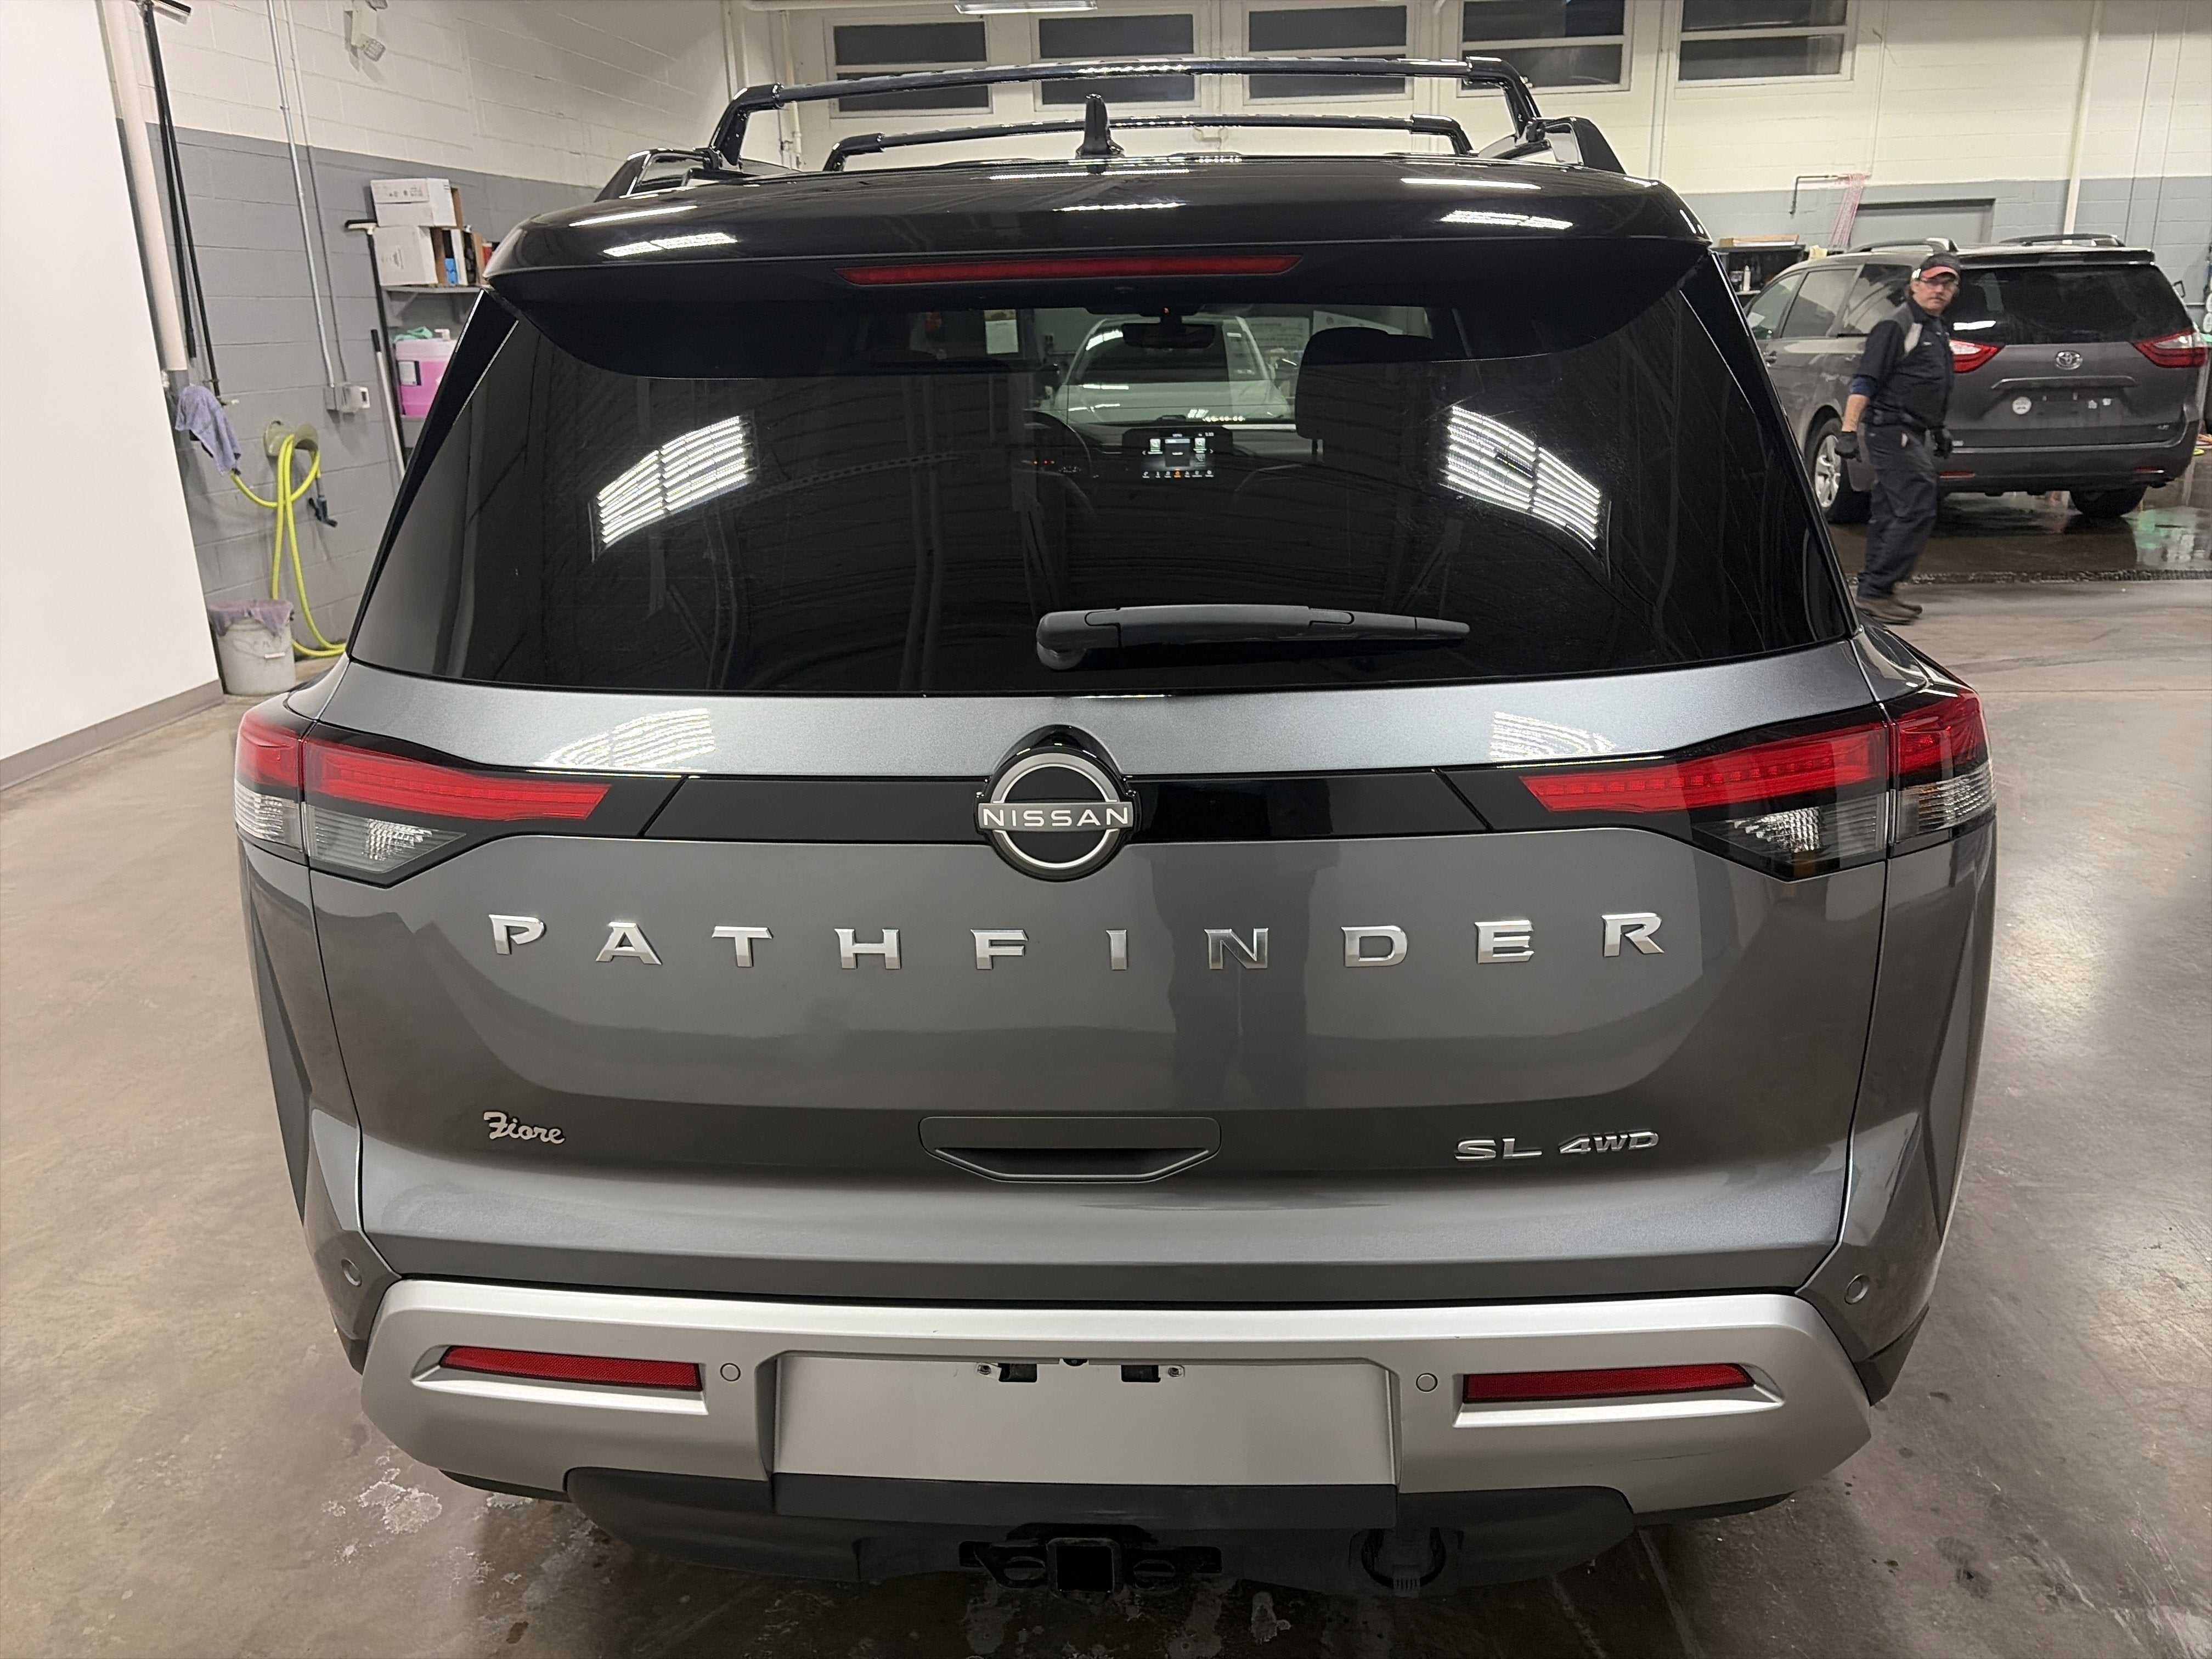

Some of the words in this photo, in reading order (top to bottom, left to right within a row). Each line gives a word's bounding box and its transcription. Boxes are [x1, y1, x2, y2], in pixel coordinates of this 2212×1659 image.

[983, 807, 1128, 826] NISSAN
[488, 912, 1664, 970] PATHFINDER
[483, 1111, 566, 1144] Fiore
[1454, 1137, 1543, 1161] SL
[1559, 1130, 1659, 1154] 4WD
